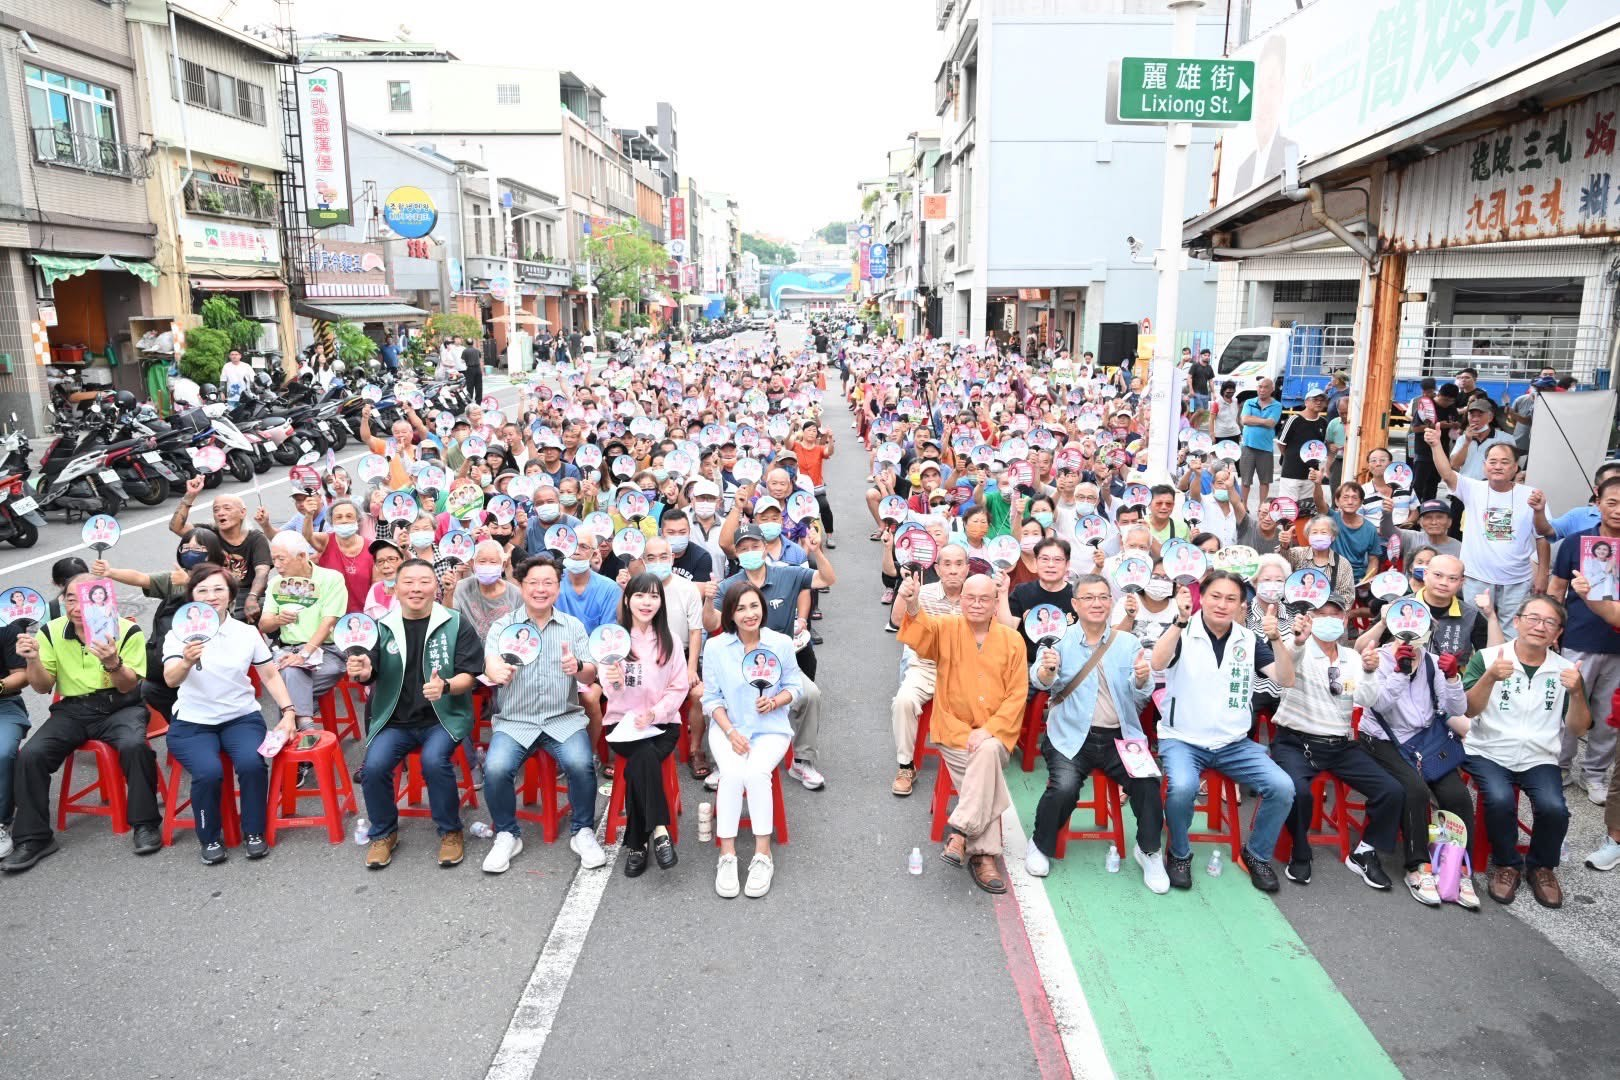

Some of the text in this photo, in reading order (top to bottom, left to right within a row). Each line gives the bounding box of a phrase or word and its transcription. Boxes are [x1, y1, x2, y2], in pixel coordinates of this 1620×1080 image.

[1142, 62, 1235, 91] 麗雄街
[1142, 94, 1232, 118] Lixiong St.
[311, 98, 333, 172] 弘爺漢堡
[625, 663, 636, 687] 黃捷
[1228, 667, 1241, 709] 林哲弘
